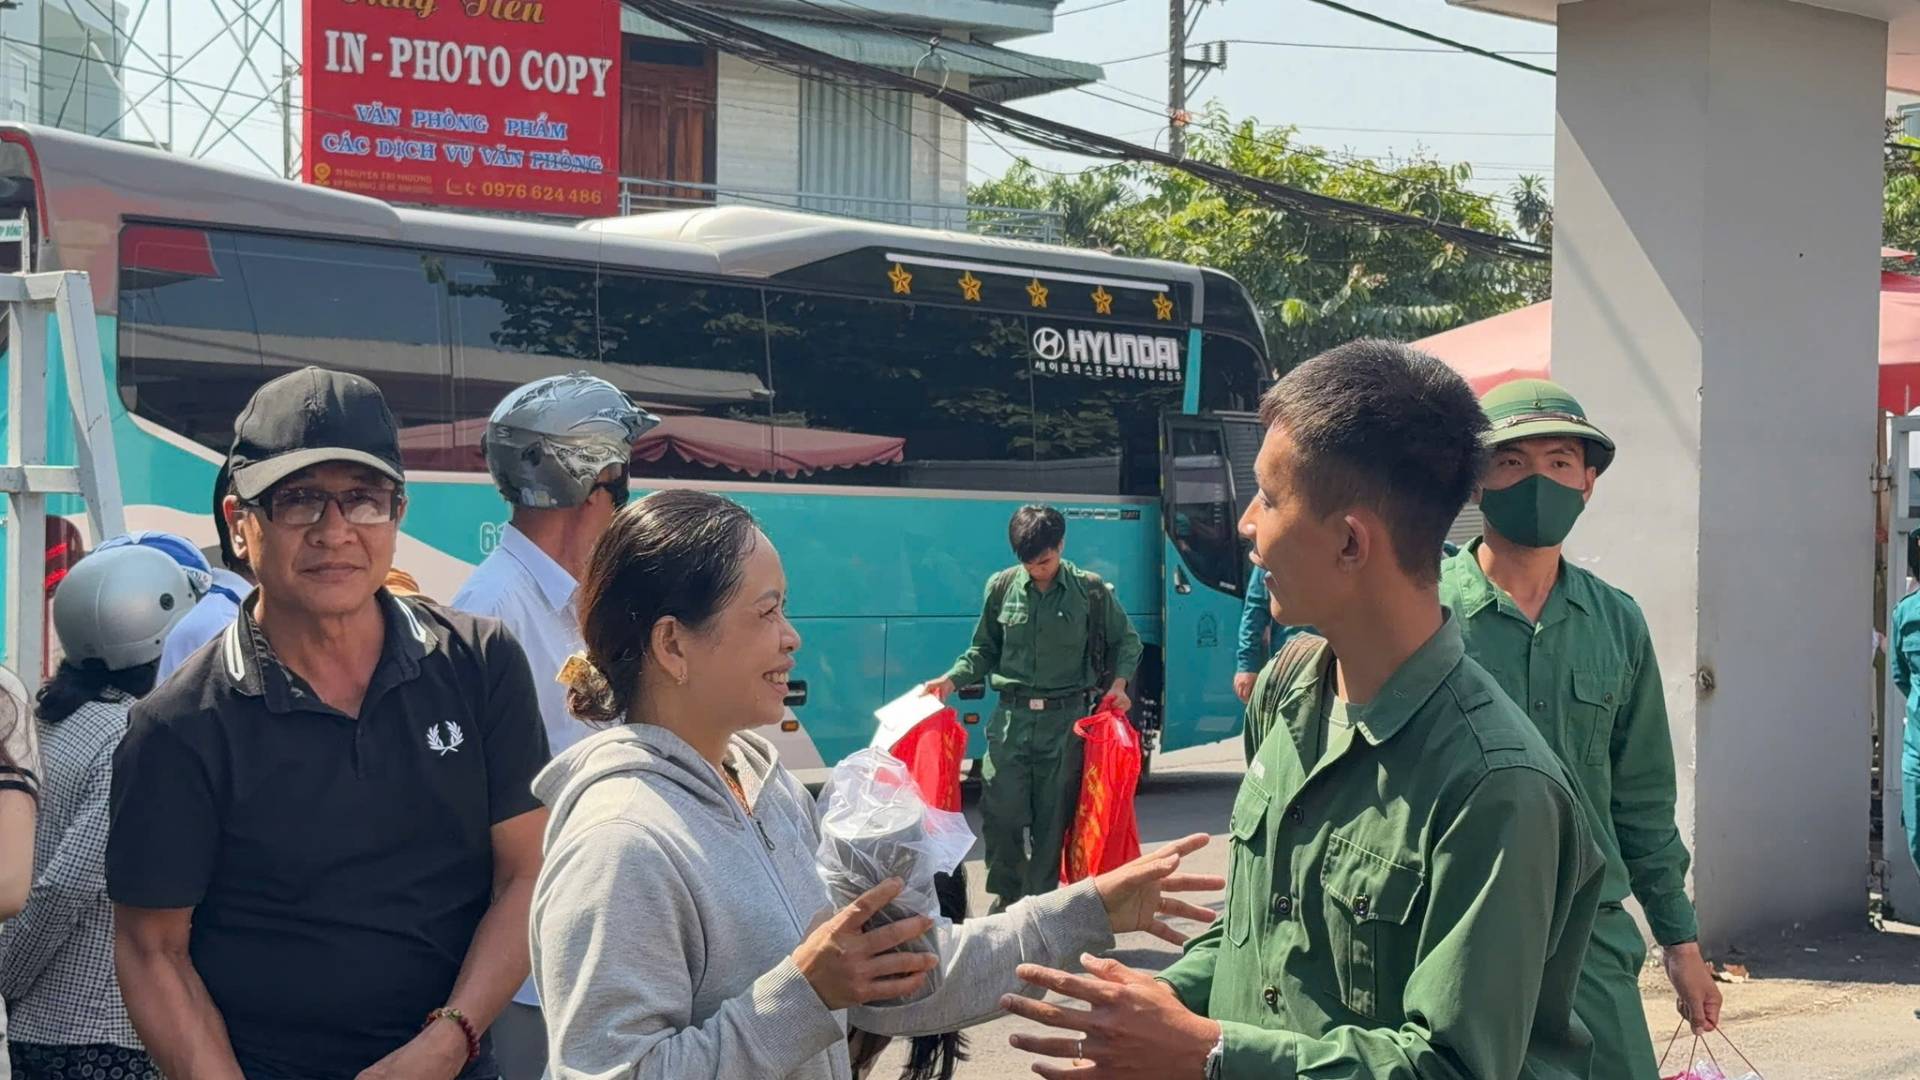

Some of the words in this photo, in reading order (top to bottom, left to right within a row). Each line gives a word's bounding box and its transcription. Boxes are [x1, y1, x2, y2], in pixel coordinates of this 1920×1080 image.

[520, 49, 613, 98] COPY
[354, 101, 401, 126] VĂN
[412, 108, 488, 133] PHÒNG
[322, 131, 370, 156] CÁC
[375, 137, 436, 162] DỊCH
[443, 143, 475, 167] VỤ
[479, 144, 524, 168] VĂN
[529, 149, 604, 174] PHÒNG
[482, 181, 527, 198] 0976
[531, 185, 565, 201] 624
[568, 190, 602, 205] 486
[1066, 328, 1180, 370] HYUNDAI
